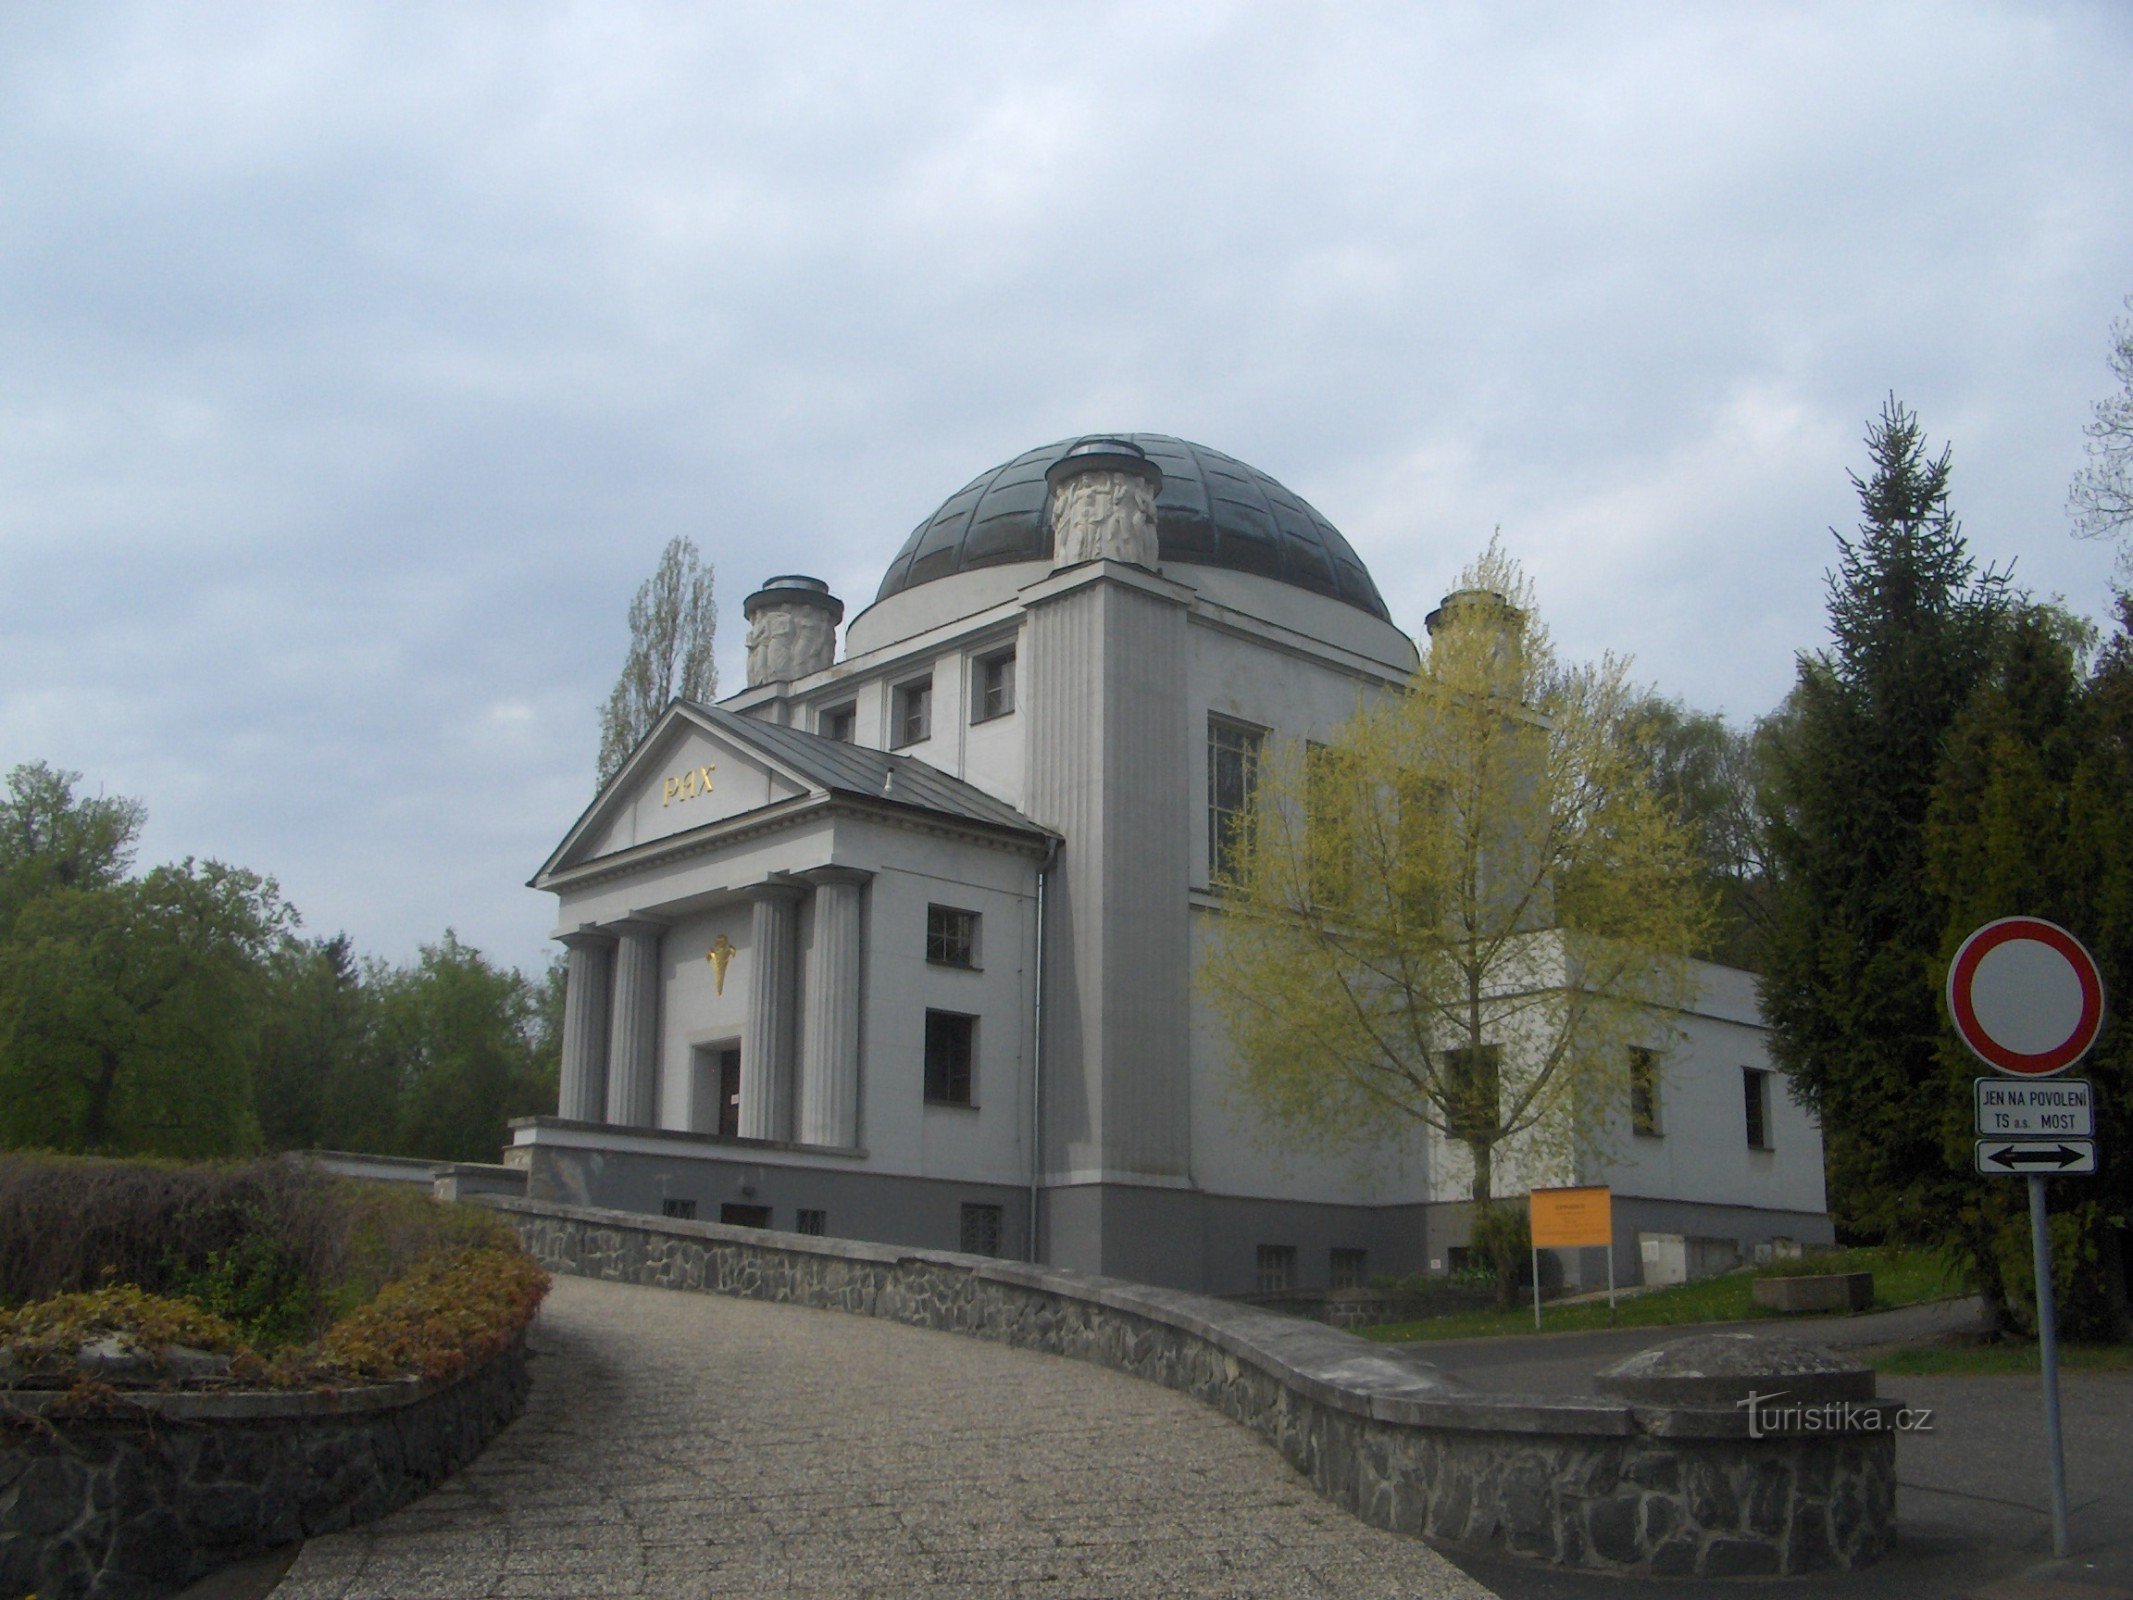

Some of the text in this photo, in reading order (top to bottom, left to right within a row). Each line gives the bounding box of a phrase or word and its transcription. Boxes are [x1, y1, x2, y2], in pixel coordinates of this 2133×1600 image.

[663, 763, 716, 808] PAX
[1983, 1088, 2087, 1106] JEN NA POVOLENÍ
[1995, 1113, 2009, 1128] TS
[2041, 1114, 2075, 1129] MOST
